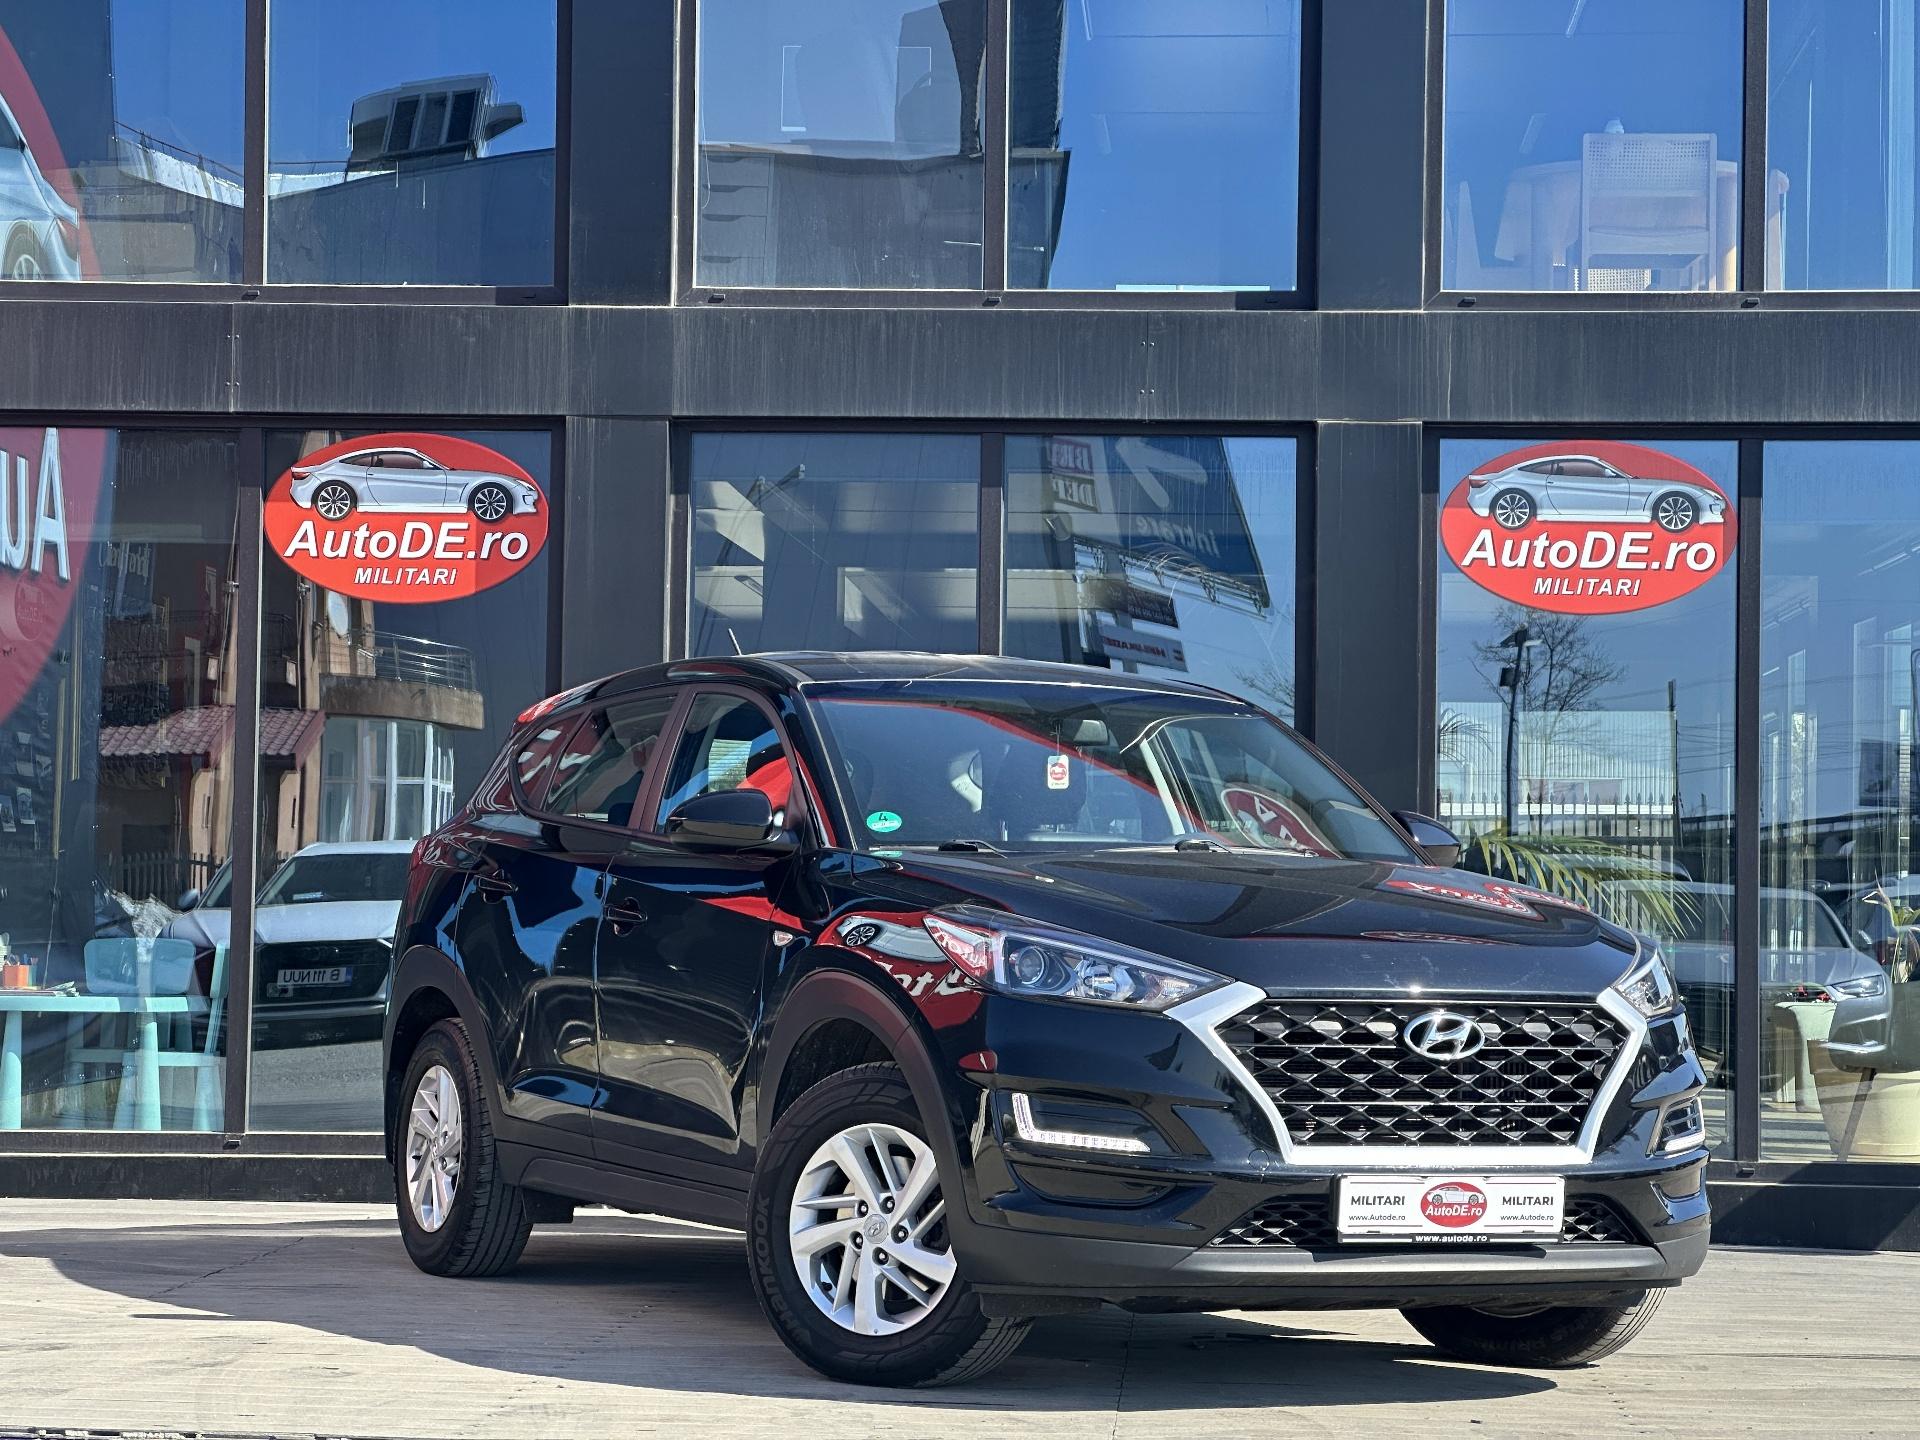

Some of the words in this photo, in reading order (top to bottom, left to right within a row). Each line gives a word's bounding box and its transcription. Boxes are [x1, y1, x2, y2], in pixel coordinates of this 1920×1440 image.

[283, 519, 529, 560] AutoDE.ro
[1460, 528, 1716, 571] AutoDE.ro
[354, 567, 457, 586] MILITARI
[1533, 577, 1641, 596] MILITARI
[1350, 1195, 1406, 1207] MILITARI
[1502, 1195, 1554, 1207] MILITARI
[1424, 1203, 1483, 1218] AutoDE.ro
[1348, 1213, 1406, 1222] www.Autode.ro
[1500, 1213, 1555, 1222] www.Autode.ro
[1415, 1234, 1488, 1243] www.autode.ro
